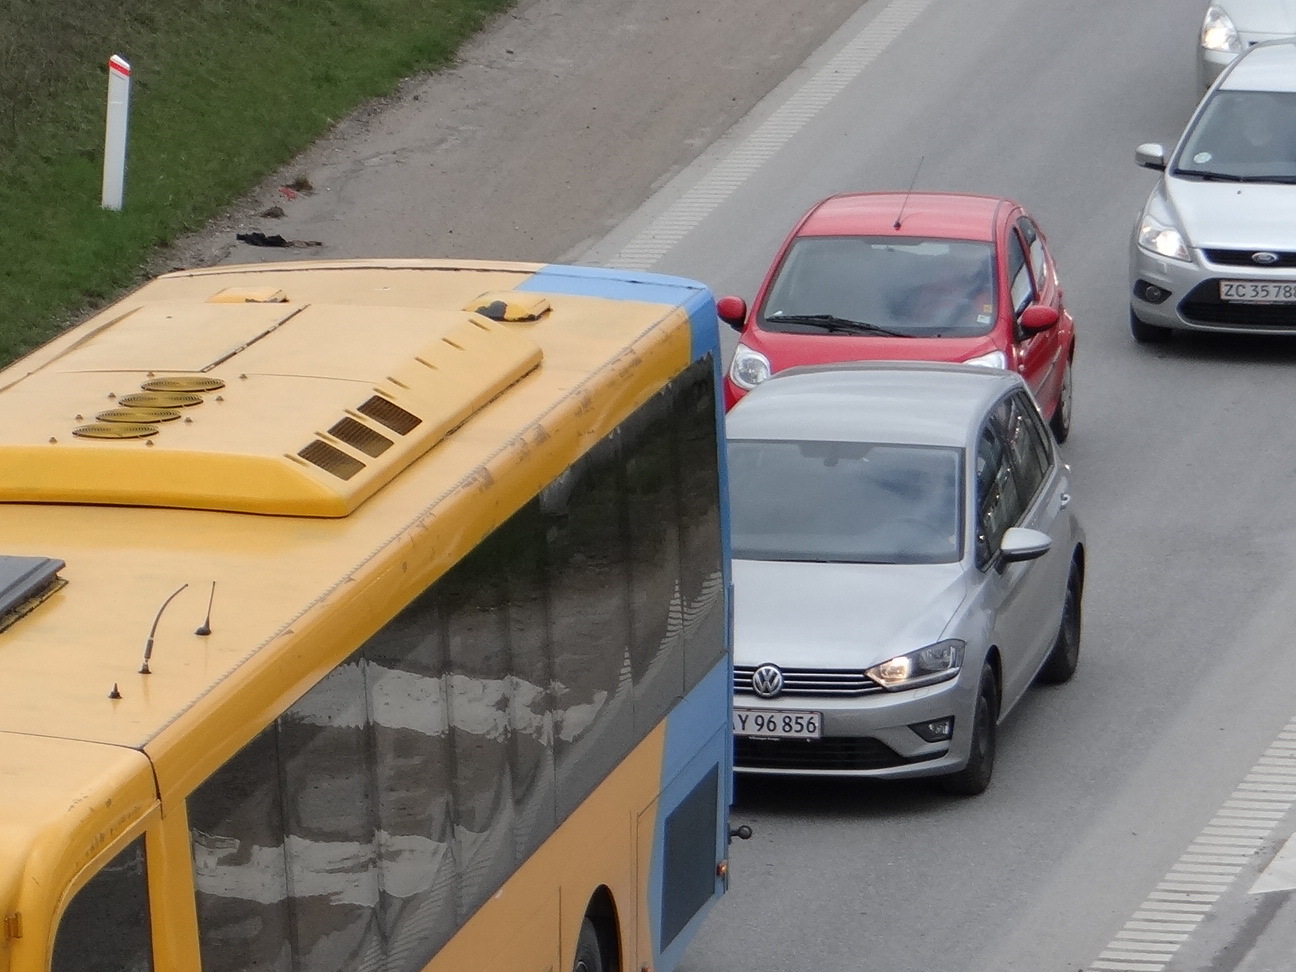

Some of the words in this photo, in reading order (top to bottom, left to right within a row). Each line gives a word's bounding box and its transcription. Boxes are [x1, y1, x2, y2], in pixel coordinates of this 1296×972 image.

[1224, 284, 1246, 298] ZC
[1249, 284, 1270, 298] 35
[754, 714, 777, 732] 96
[782, 715, 817, 734] 856
